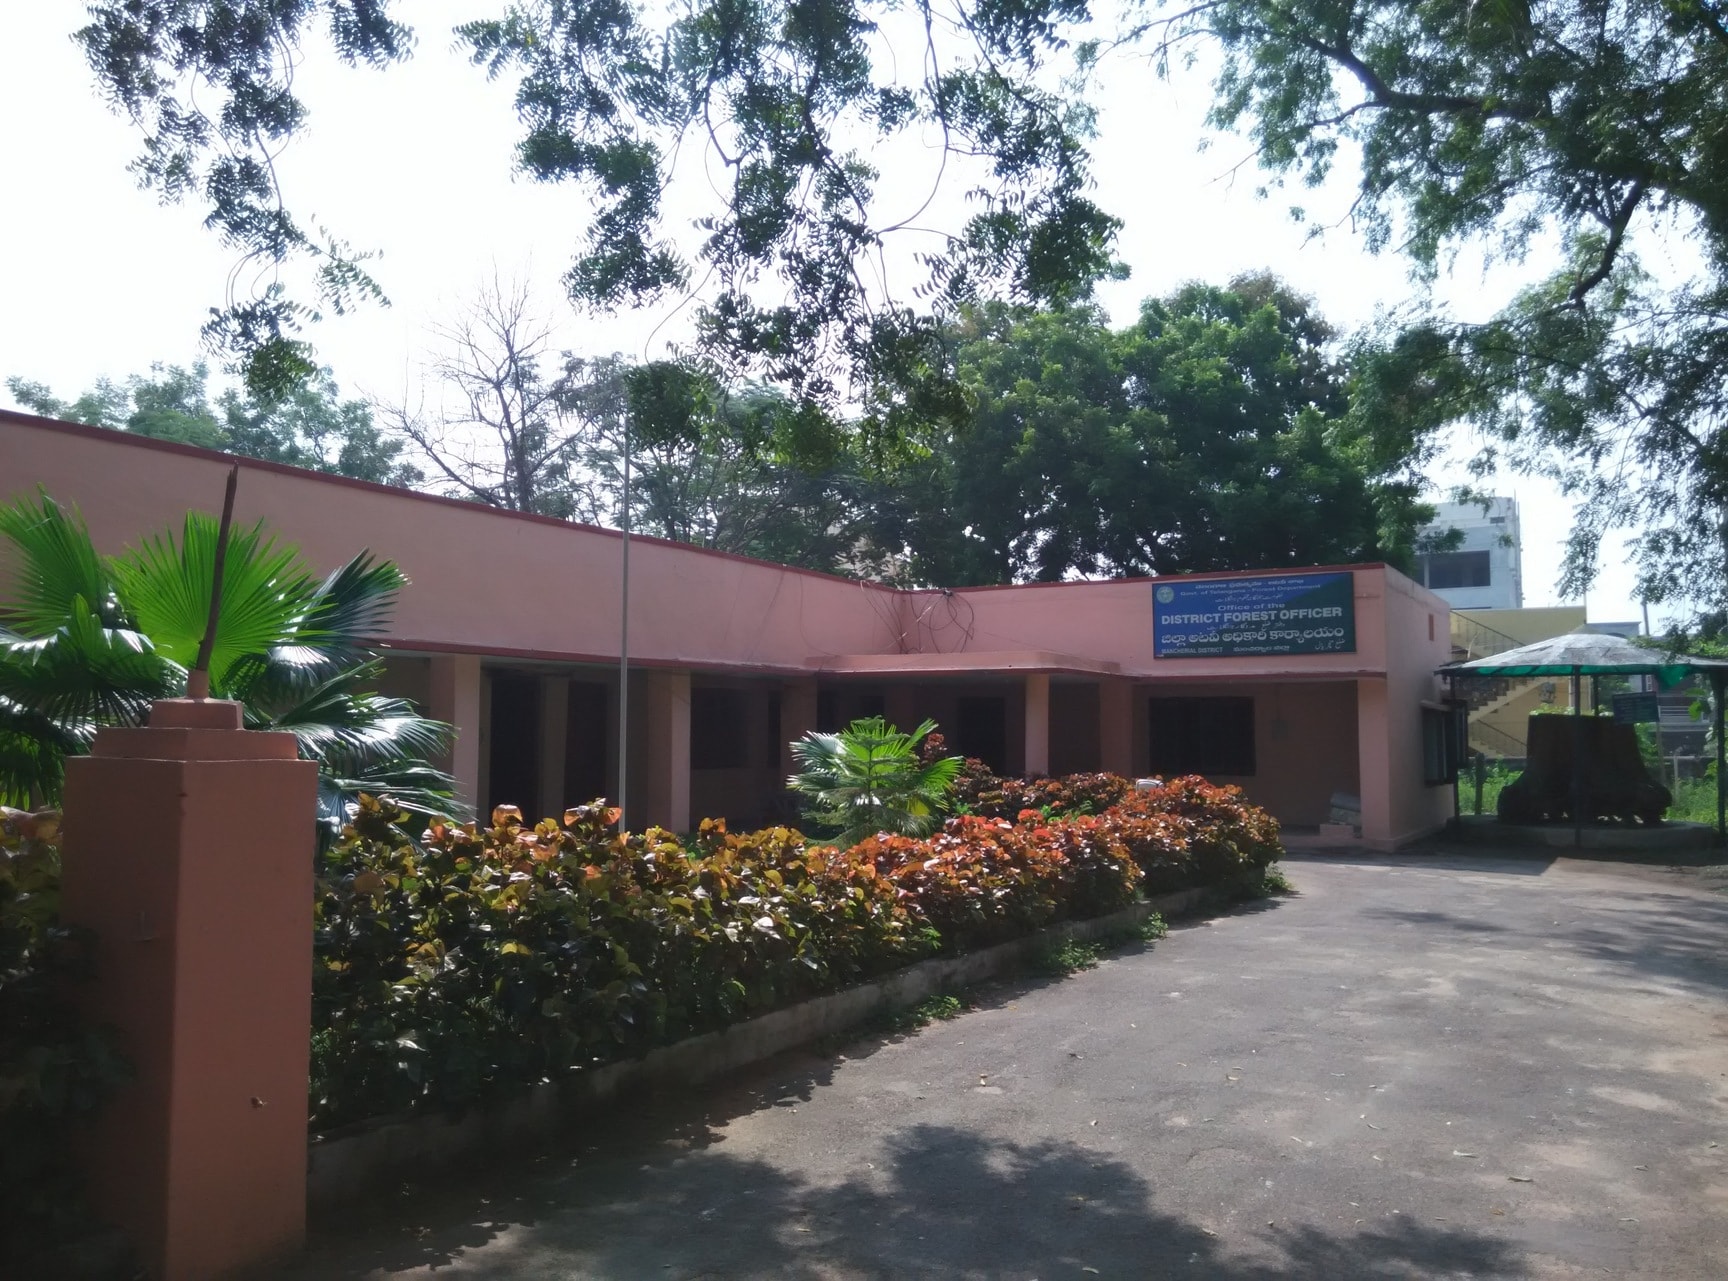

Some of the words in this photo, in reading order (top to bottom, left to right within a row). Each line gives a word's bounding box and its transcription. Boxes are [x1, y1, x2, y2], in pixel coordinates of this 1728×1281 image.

[1161, 614, 1221, 624] DISTRICT
[1224, 611, 1278, 622] FOREST
[1280, 607, 1342, 619] OFFICER
[1161, 634, 1186, 646] జిల్లా
[1189, 631, 1219, 642] అటవీ
[1222, 630, 1267, 643] అధికారి
[1269, 627, 1344, 643] కార్యాలయం
